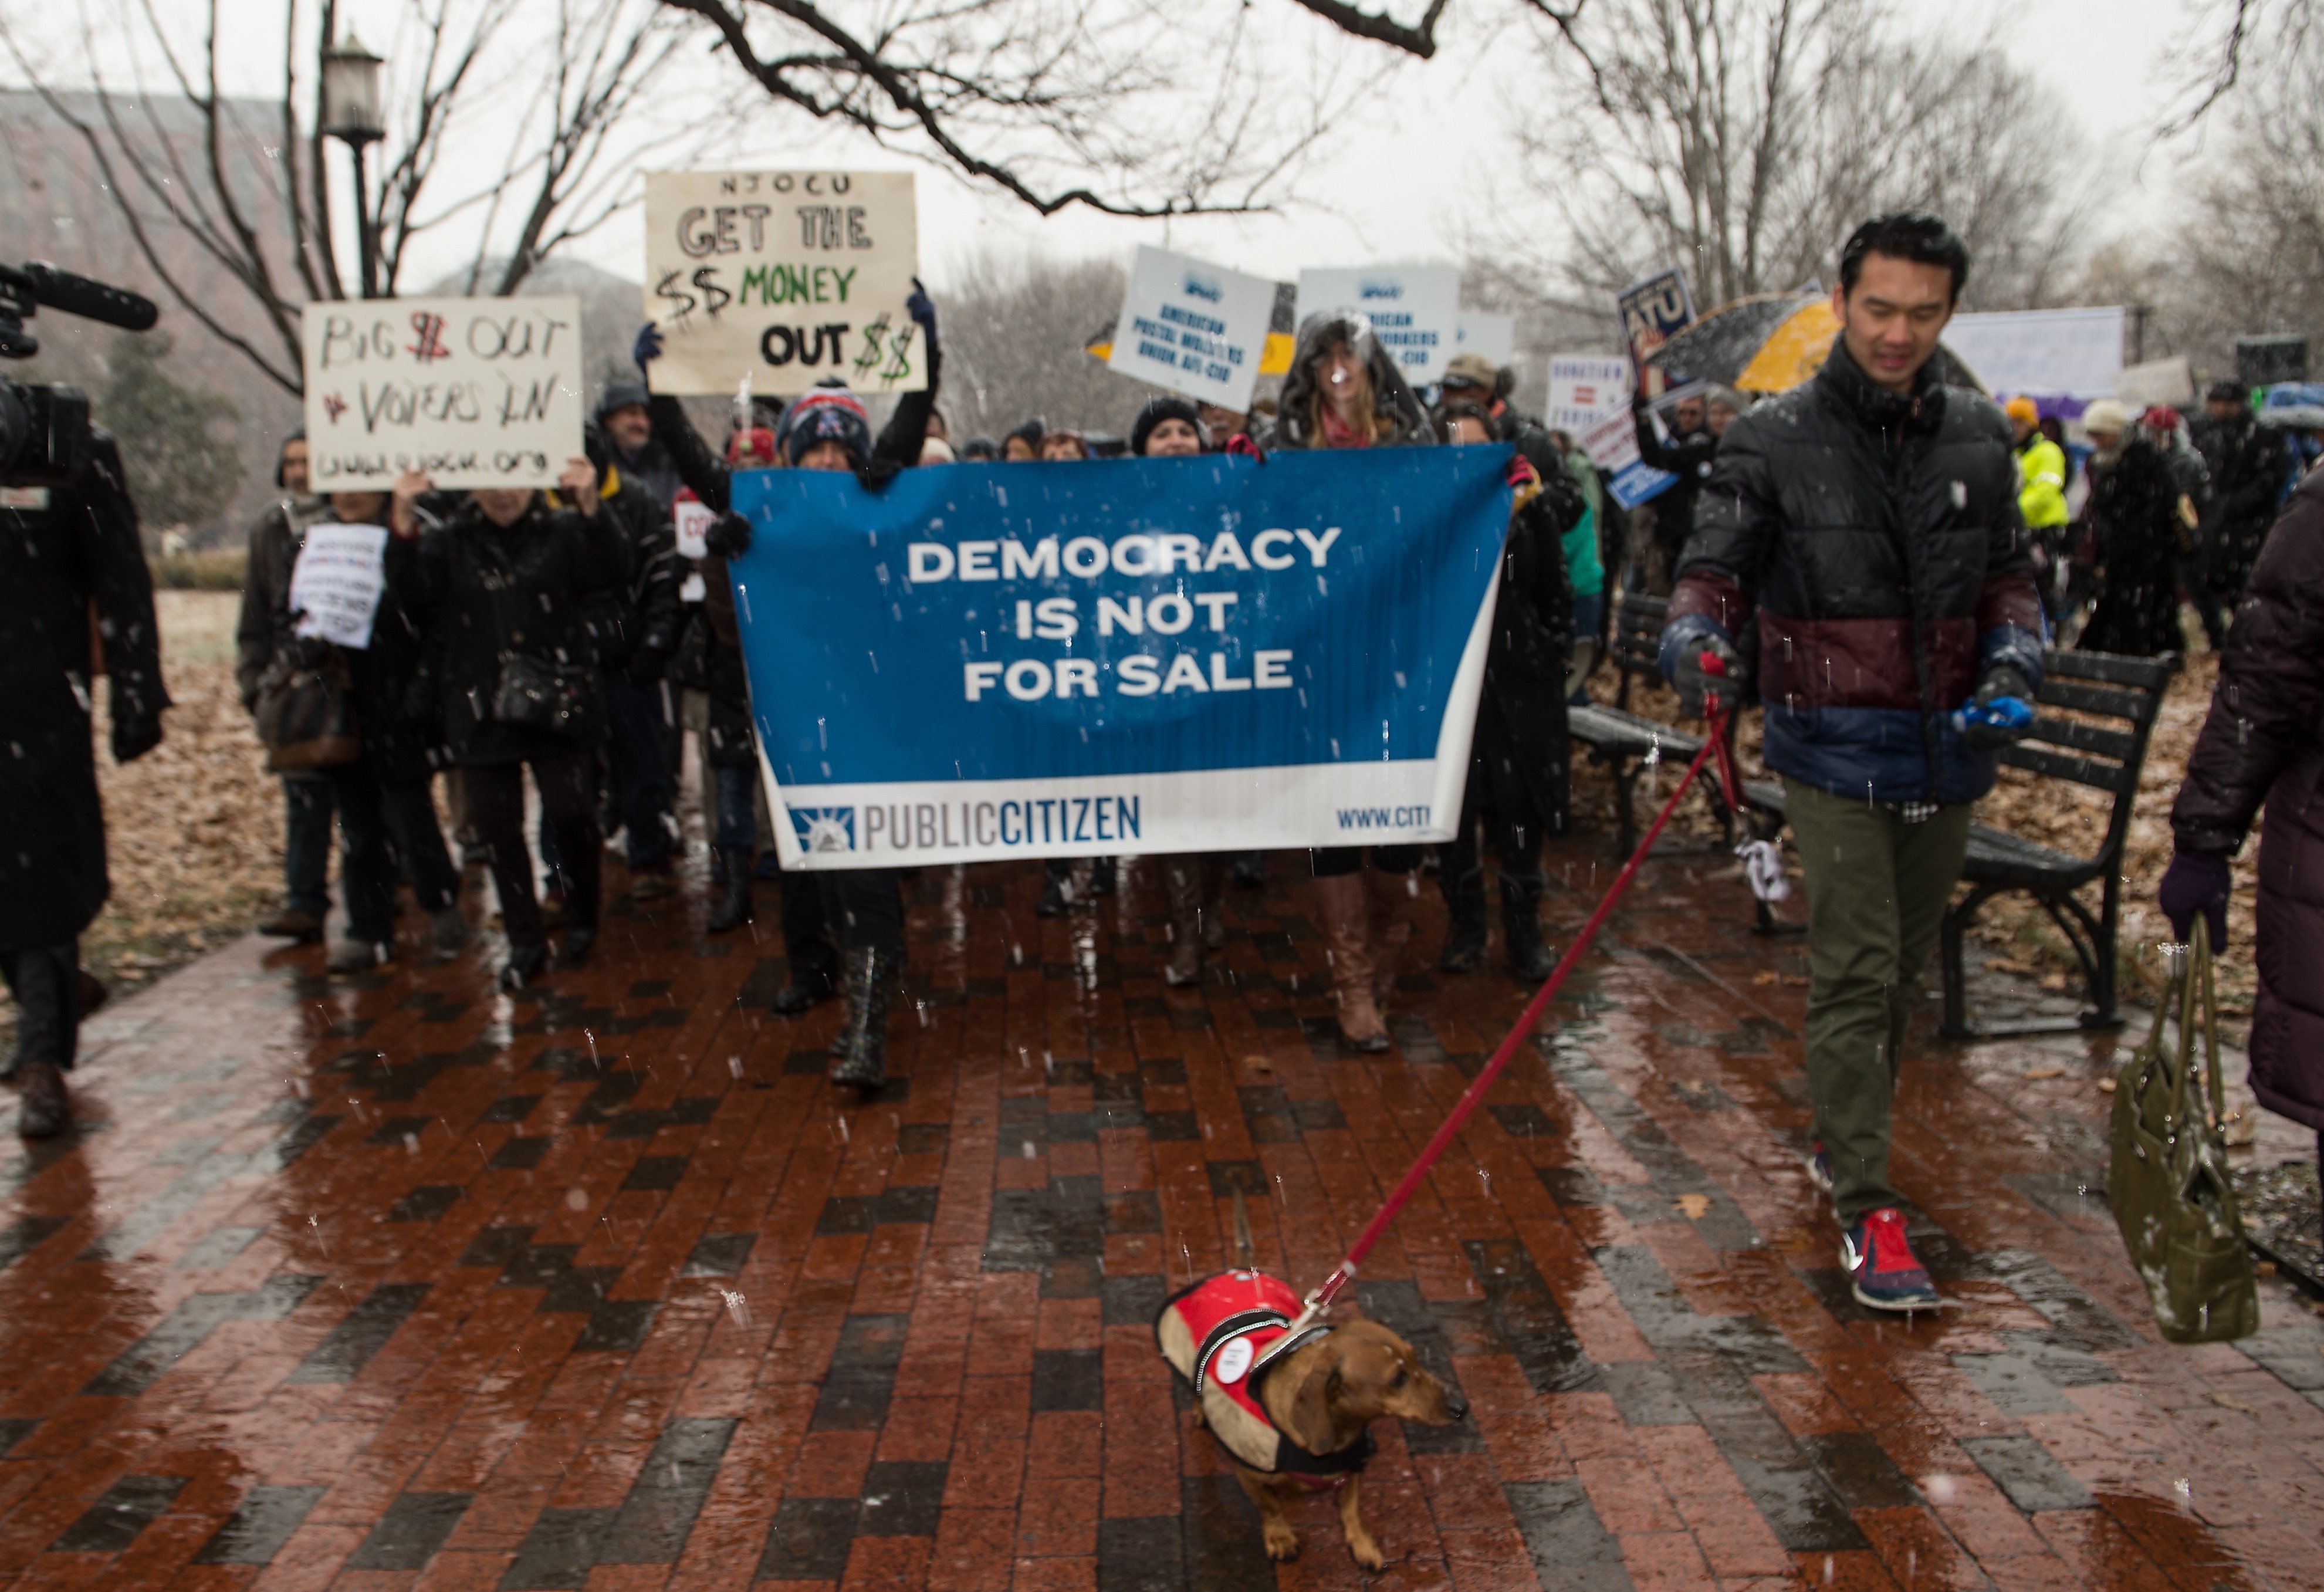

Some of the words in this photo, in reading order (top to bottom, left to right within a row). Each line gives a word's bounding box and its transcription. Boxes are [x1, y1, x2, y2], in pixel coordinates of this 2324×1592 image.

[676, 204, 770, 258] GET
[796, 205, 873, 249] THE
[739, 262, 857, 305] MONEY
[320, 313, 395, 369] BIG
[467, 308, 569, 360] OUT
[761, 323, 850, 367] OUT
[1159, 303, 1225, 334] AMERICAN
[358, 376, 485, 434] VOTERS
[496, 367, 559, 427] IN
[907, 526, 1342, 583] DEMOCRACY
[1015, 596, 1080, 640] IS
[1098, 591, 1239, 637] NOT
[963, 657, 1100, 702] FOR
[1116, 649, 1293, 698] SALE
